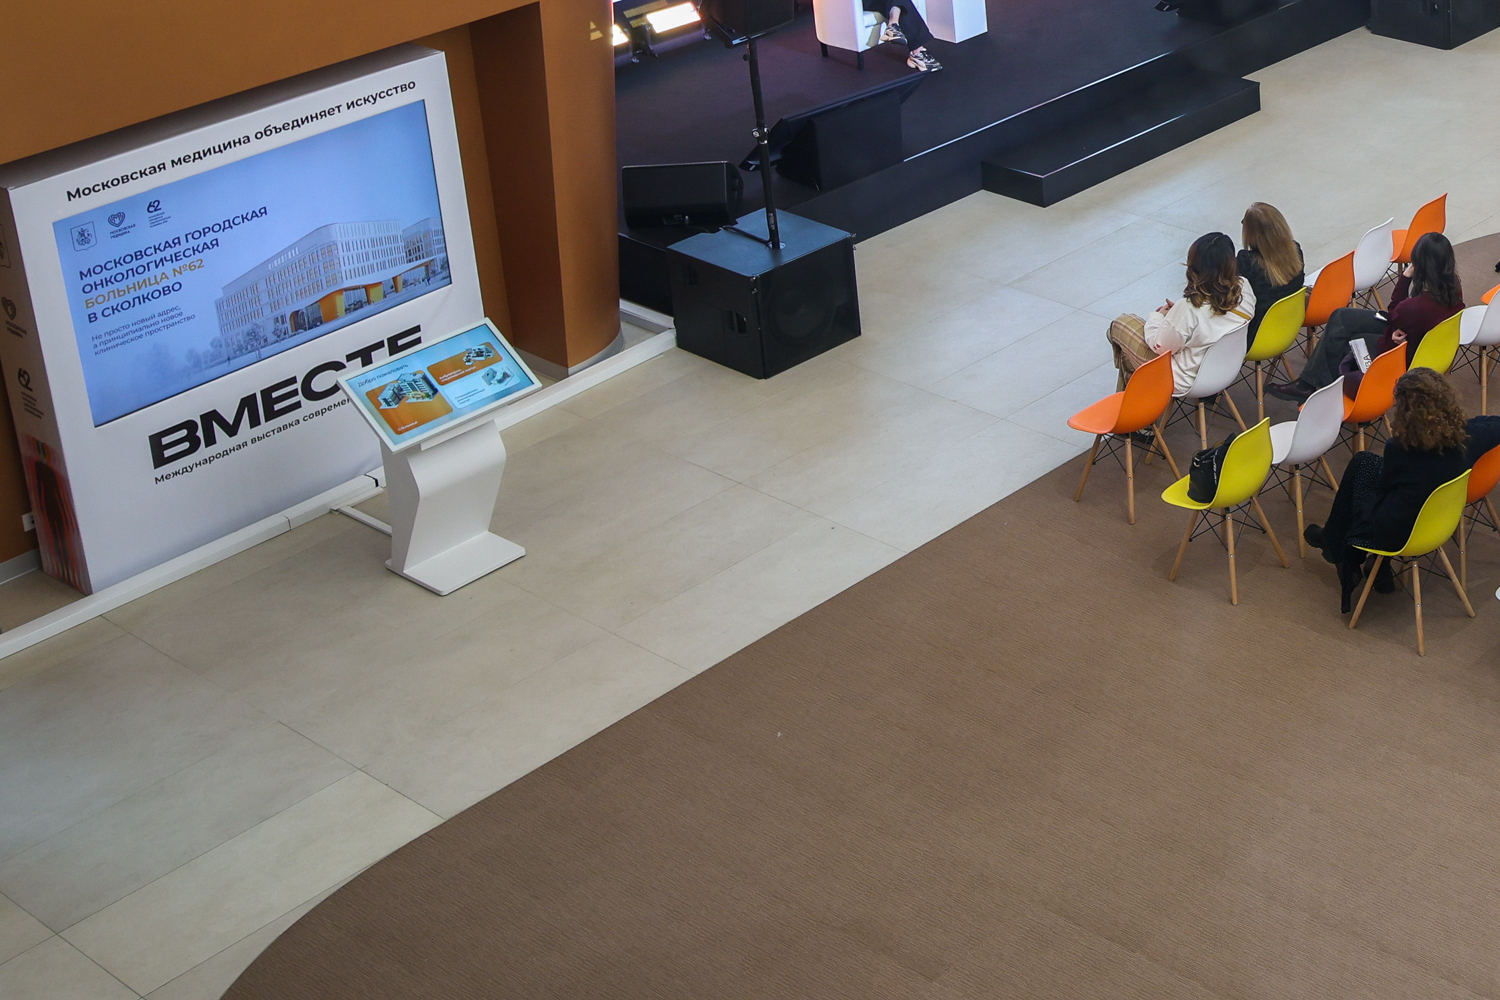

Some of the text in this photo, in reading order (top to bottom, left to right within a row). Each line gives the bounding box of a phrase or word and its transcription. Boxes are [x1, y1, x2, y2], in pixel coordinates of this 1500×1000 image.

[66, 78, 417, 202] Московская медицина объединяет искусство
[146, 199, 163, 214] 62
[79, 206, 269, 281] МОСКОВСКАЯ ГОРОДСКАЯ
[82, 238, 220, 294] ОНКОЛОГИЧЕСКАЯ
[84, 258, 205, 310] БОЛЬНИЦА №62
[87, 281, 183, 324] В СКОЛКОВО
[91, 333, 103, 342] Не
[103, 324, 130, 339] просто
[131, 313, 156, 328] новый
[94, 314, 196, 356] клиническое пространство
[99, 320, 160, 347] принципиально
[161, 311, 184, 325] новое
[148, 324, 422, 470] ВМЕСТЕ
[154, 440, 249, 485] Международная
[250, 419, 301, 445] выставка
